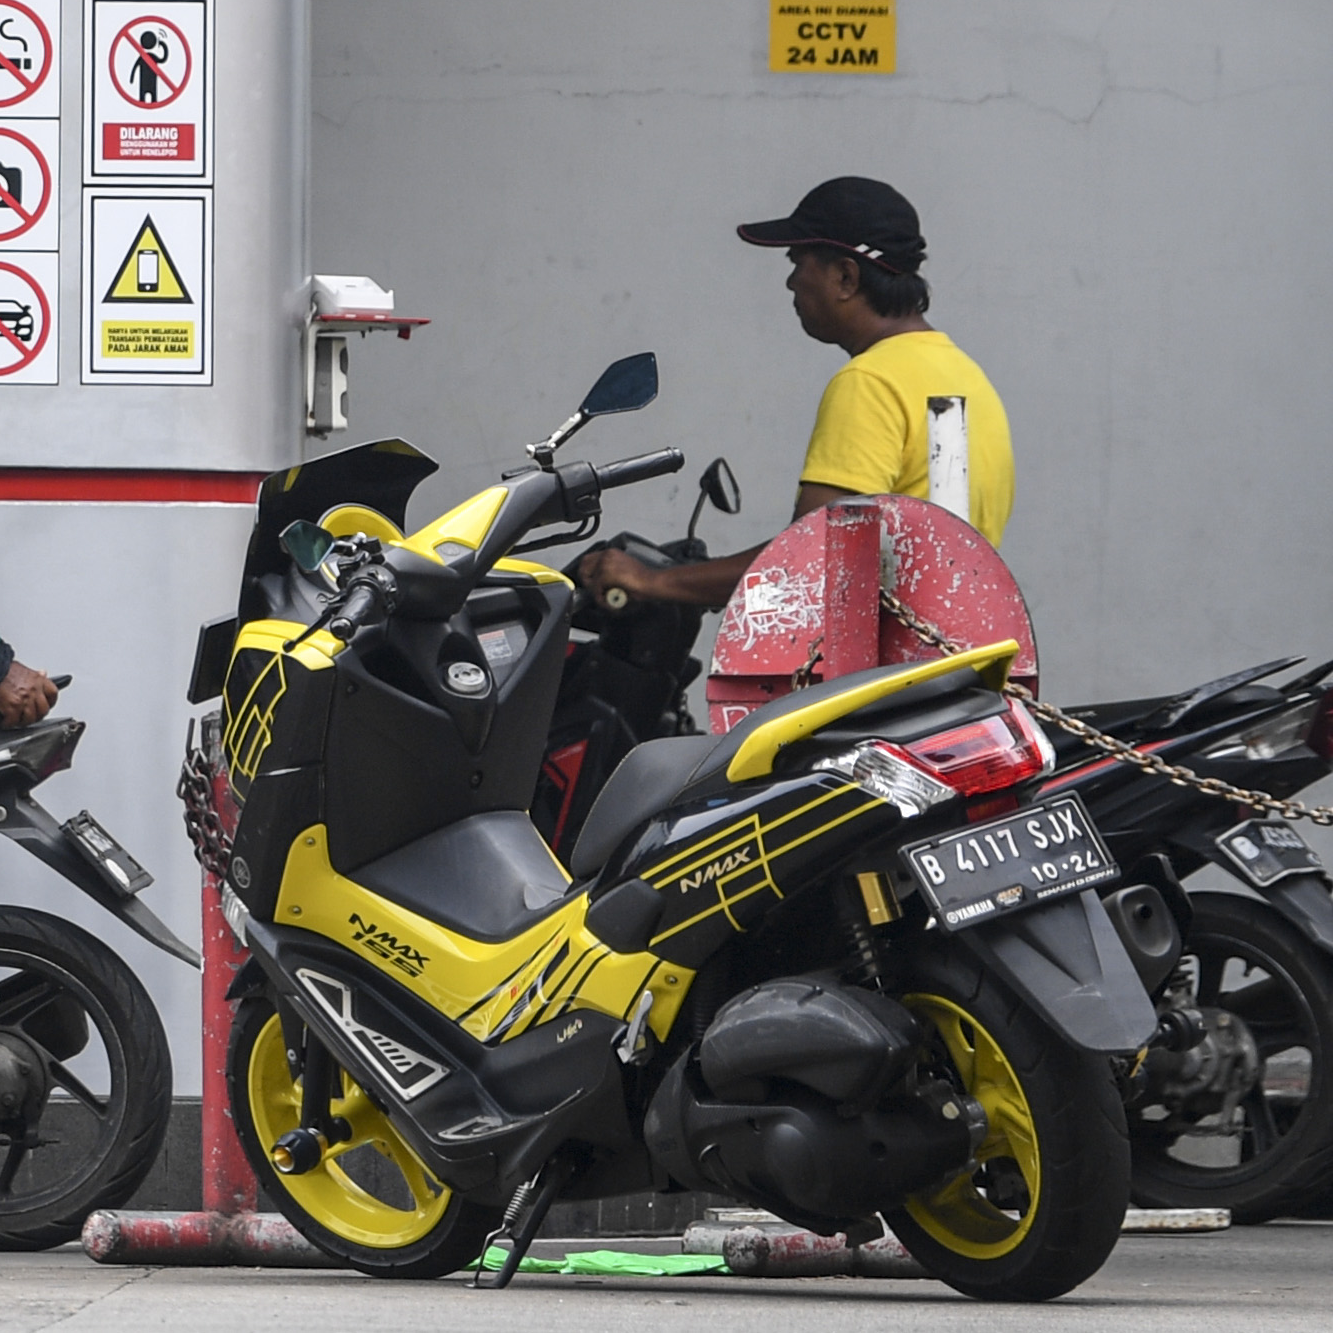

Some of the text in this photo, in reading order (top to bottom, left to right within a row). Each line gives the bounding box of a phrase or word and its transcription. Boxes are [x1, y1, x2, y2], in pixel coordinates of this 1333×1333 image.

[778, 5, 811, 15] AREA
[815, 6, 832, 15] INI
[797, 22, 867, 41] CCTV
[787, 47, 879, 65] 24 JAM
[119, 127, 178, 140] DILARANG
[108, 344, 189, 353] PADA JARAK AMAN
[920, 808, 1082, 887] B 4117 SJX
[680, 847, 751, 894] NMAX
[957, 899, 996, 921] YAMAHA
[348, 913, 431, 968] NMAX
[351, 932, 424, 978] 155
